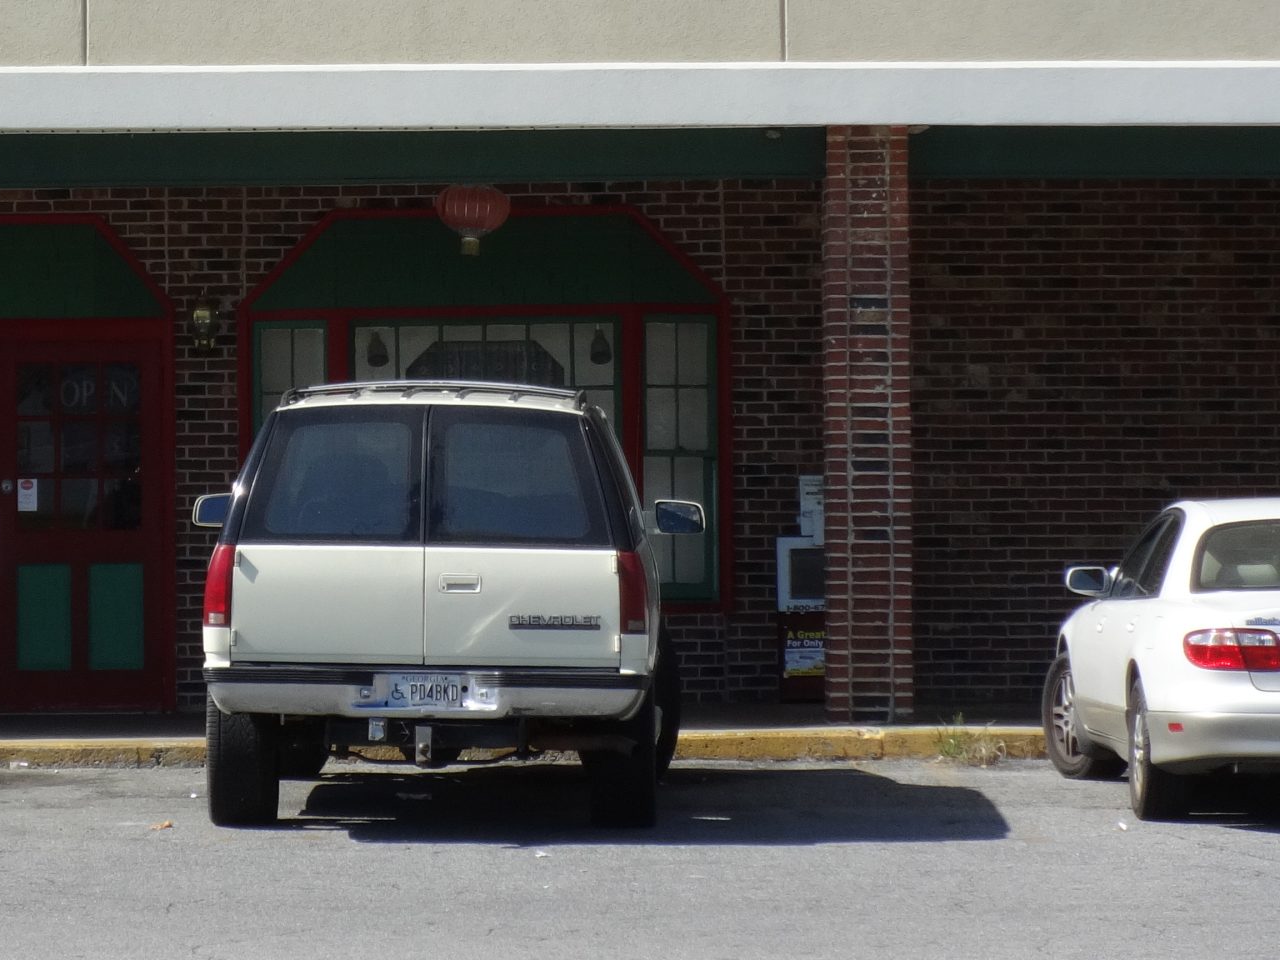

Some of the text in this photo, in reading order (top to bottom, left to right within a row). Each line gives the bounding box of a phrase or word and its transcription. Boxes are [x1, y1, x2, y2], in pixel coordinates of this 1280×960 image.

[61, 379, 128, 407] OPN
[508, 615, 601, 626] CHEVROLET
[803, 640, 824, 649] Only
[405, 675, 446, 683] GEORGIA
